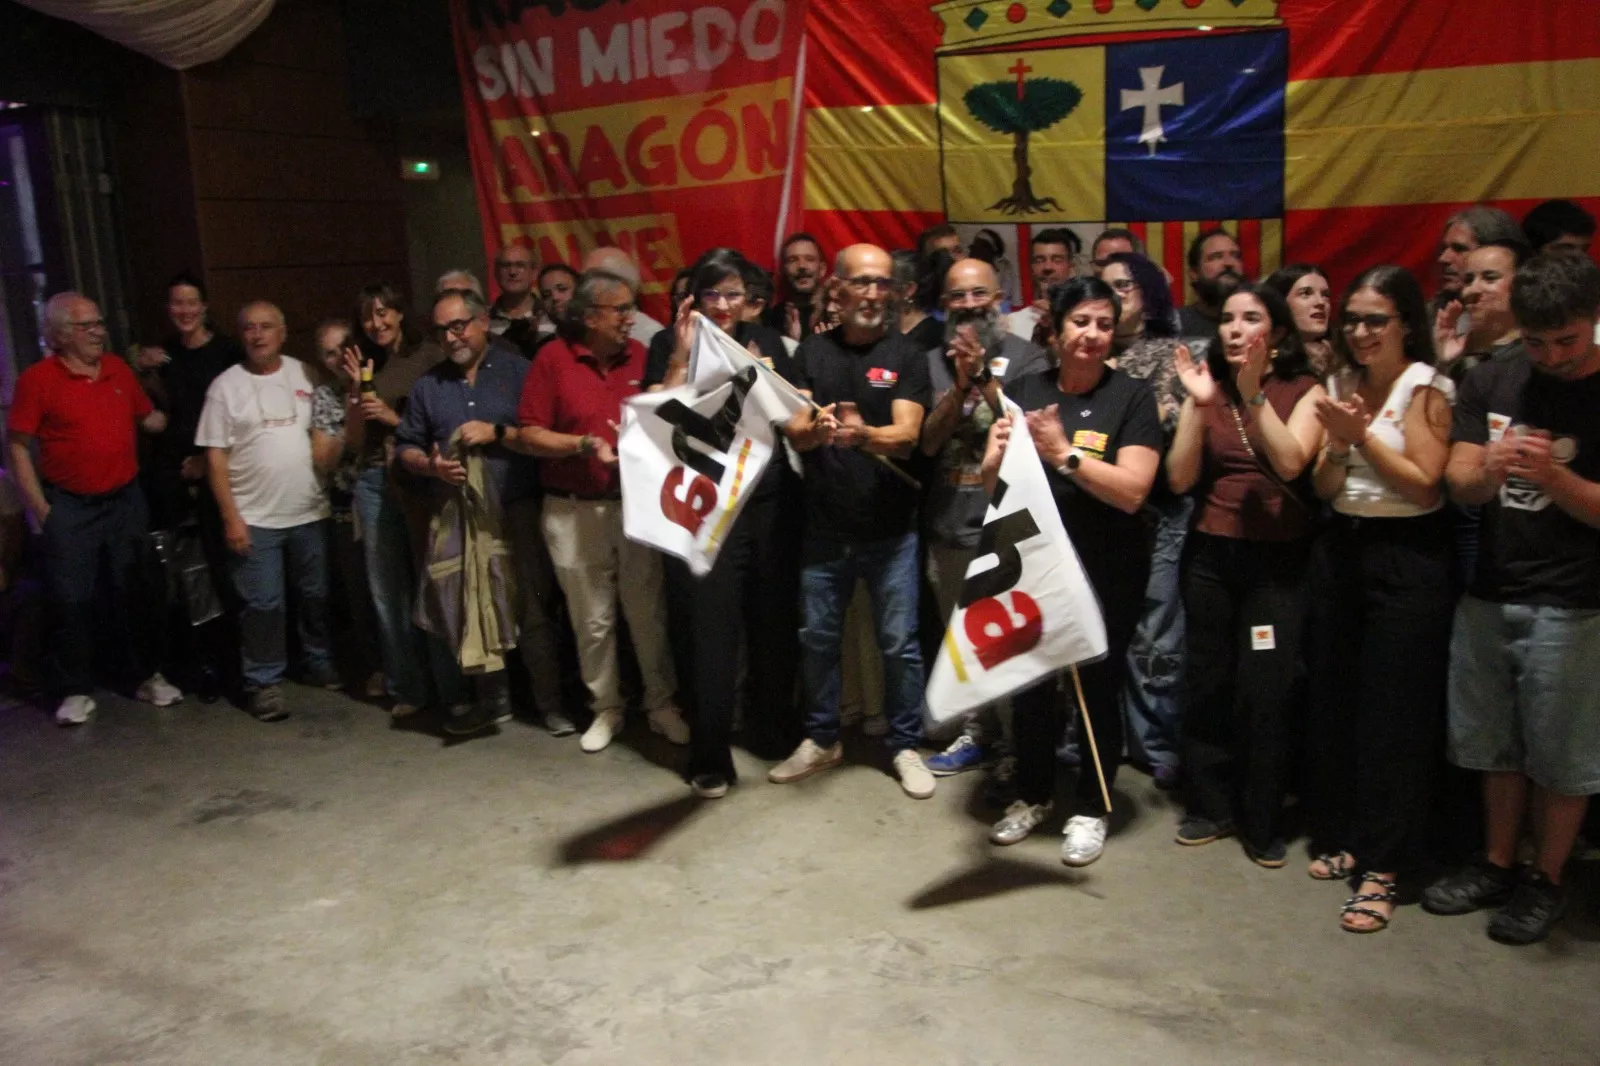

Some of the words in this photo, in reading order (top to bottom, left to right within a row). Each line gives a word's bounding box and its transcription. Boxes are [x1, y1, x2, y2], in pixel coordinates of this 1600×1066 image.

[474, 36, 556, 101] SIN
[578, 0, 786, 88] MIEDO
[502, 93, 791, 197] ARAGÓN
[957, 476, 1044, 672] ha
